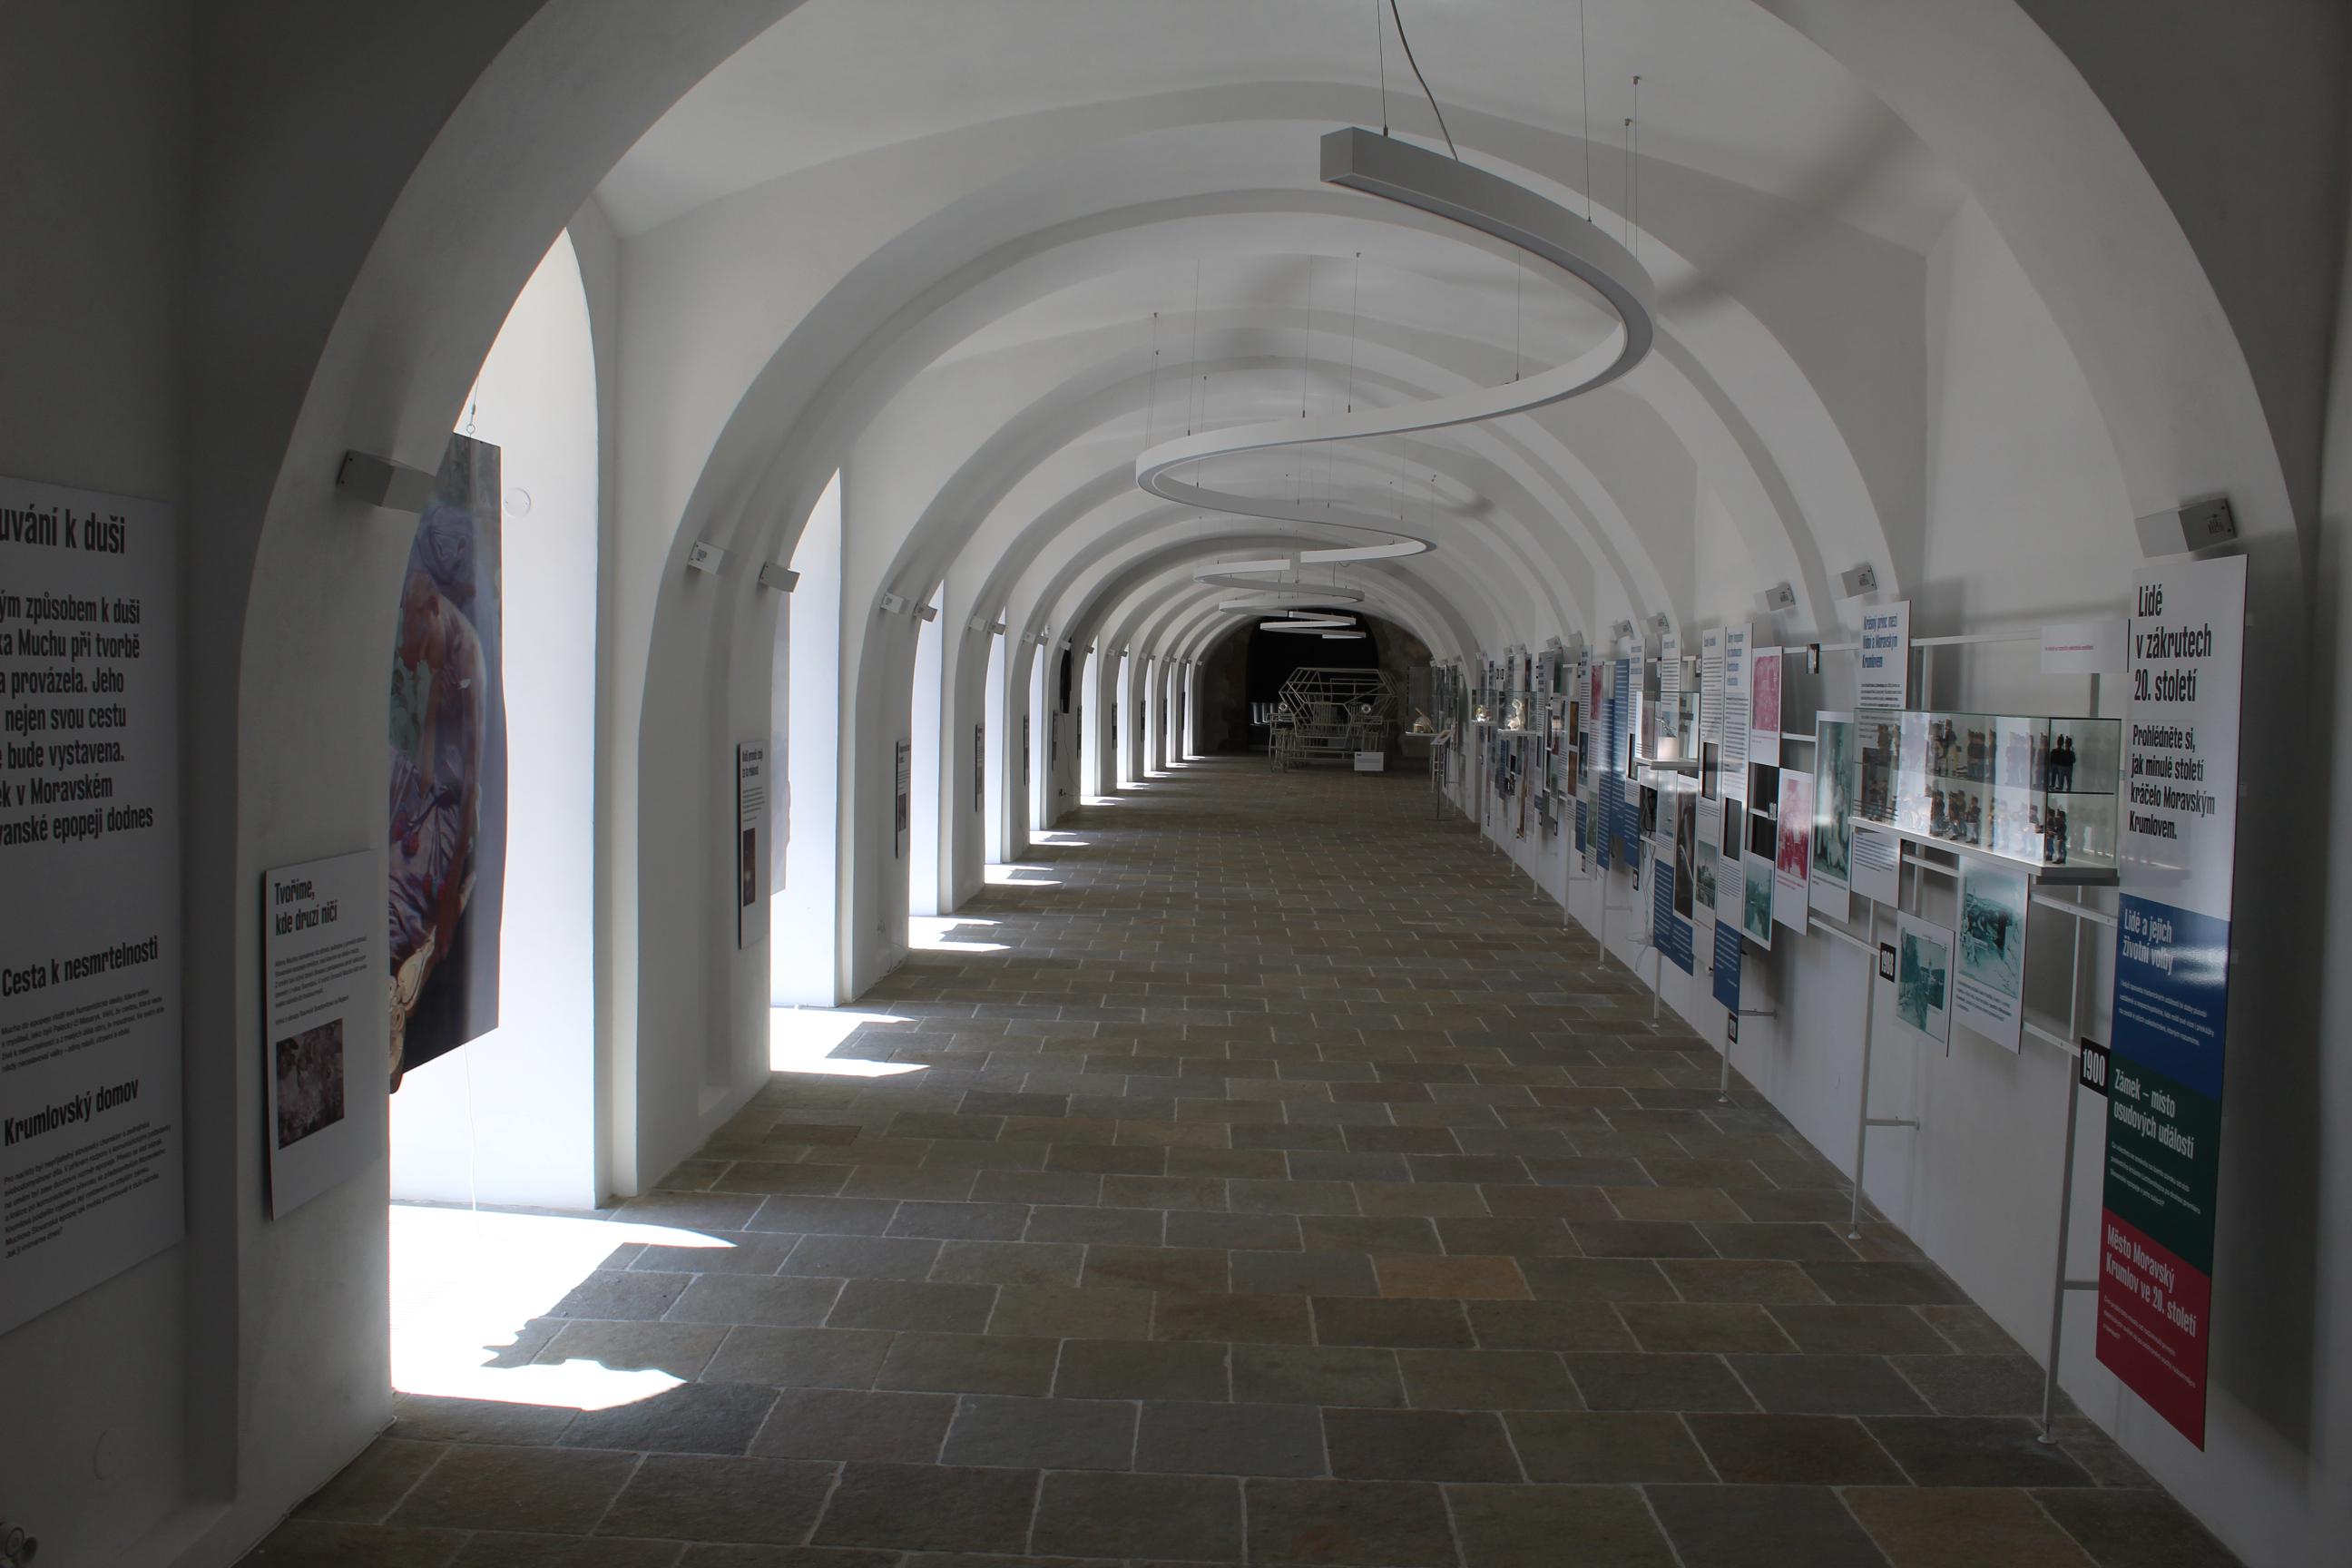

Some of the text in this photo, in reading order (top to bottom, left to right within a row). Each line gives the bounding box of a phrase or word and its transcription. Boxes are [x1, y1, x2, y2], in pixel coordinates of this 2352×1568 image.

[65, 509, 76, 549] k
[84, 513, 124, 554] duši
[26, 591, 97, 624] způsobem
[101, 596, 109, 622] k
[113, 598, 140, 624] duši
[2138, 583, 2162, 617] Lidé
[18, 628, 65, 656] Muchu
[71, 632, 91, 662] při
[95, 633, 140, 658] tvorbě
[2136, 622, 2211, 659] v zákrutech
[11, 667, 88, 699] provázela.
[92, 667, 124, 693] Jeho
[2133, 668, 2197, 702] 20. století
[5, 703, 126, 736] nejen svou cestu
[7, 740, 124, 771] bude vystavena.
[2132, 724, 2196, 753] Prohlédněte si,
[2131, 753, 2204, 782] jak minulé století
[0, 773, 113, 808] k v Moravském
[2131, 781, 2215, 818] kráčelo Moravským
[53, 808, 102, 843] epopeji
[106, 805, 153, 832] dodnes
[2129, 809, 2177, 840] Krumlovem.
[275, 878, 315, 906] Tvoříme,
[276, 899, 338, 936] kde druzí ničí
[2124, 908, 2172, 944] Lidé a jejich
[2, 934, 158, 997] Cesta k nesmrtelnosti
[2122, 935, 2175, 976] životní volby
[2082, 1048, 2105, 1087] 1900
[2114, 1068, 2141, 1101] Zámek
[2151, 1090, 2175, 1118] místo
[5, 1079, 138, 1147] Krumlovský domov
[2114, 1102, 2195, 1160] osudových událostí
[2107, 1223, 2175, 1294] Město Moravský
[2106, 1251, 2196, 1338] Krumlov ve 20. století
